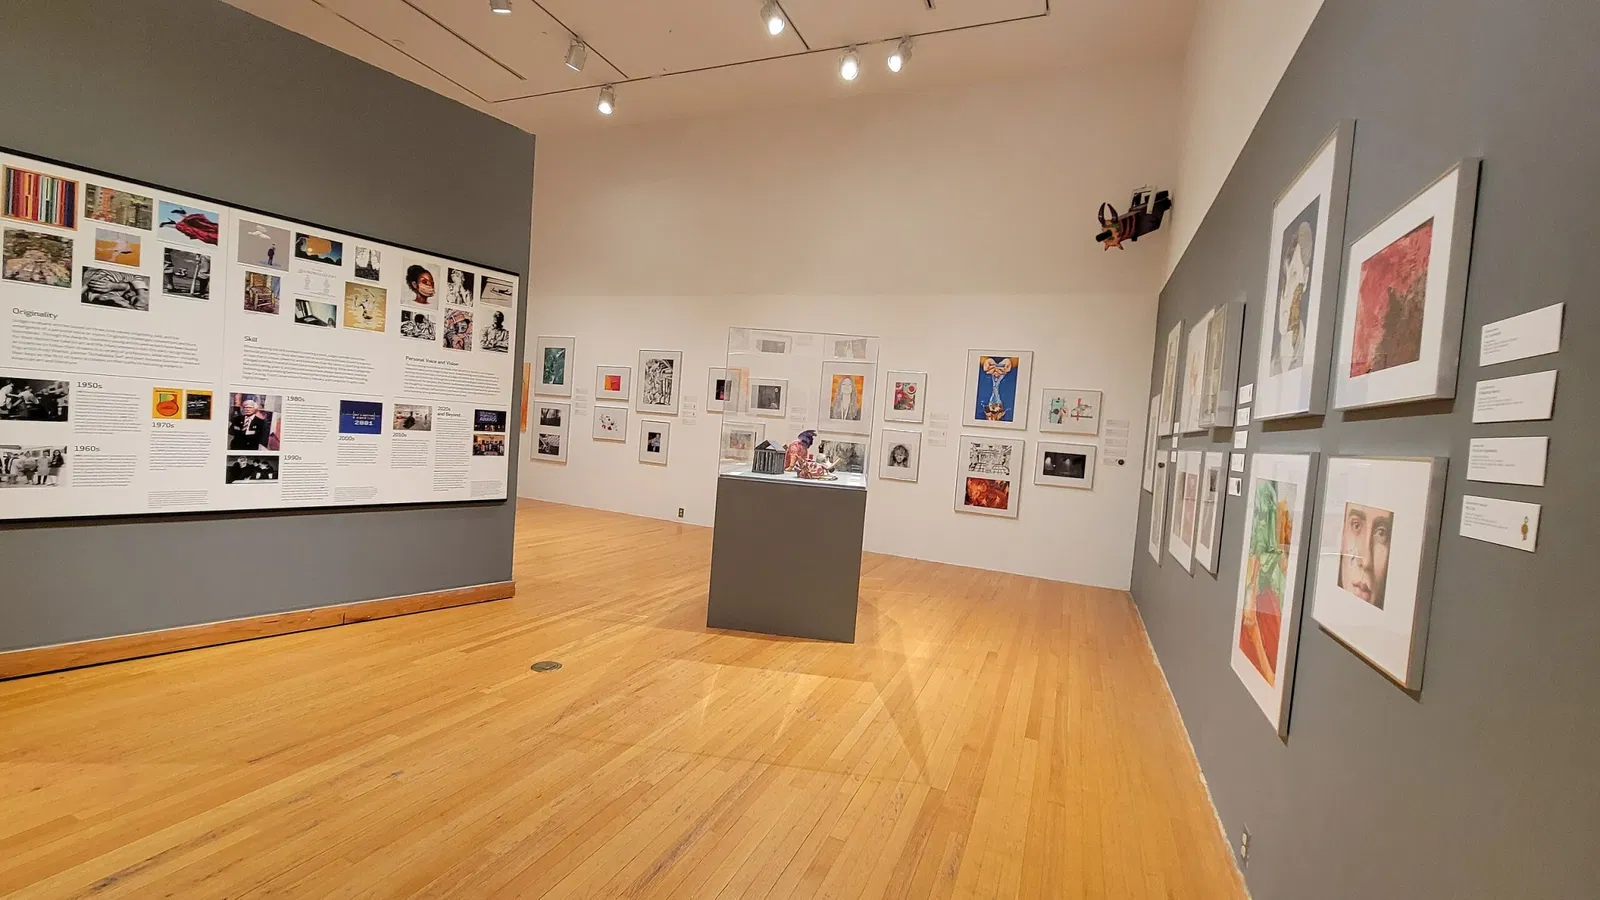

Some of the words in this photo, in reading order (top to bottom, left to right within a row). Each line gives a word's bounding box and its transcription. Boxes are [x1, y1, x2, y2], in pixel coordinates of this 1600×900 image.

[12, 307, 58, 320] Originality
[244, 335, 258, 343] Skill
[76, 381, 103, 389] 1950s
[151, 421, 175, 429] 1970s
[74, 445, 100, 453] 1960s
